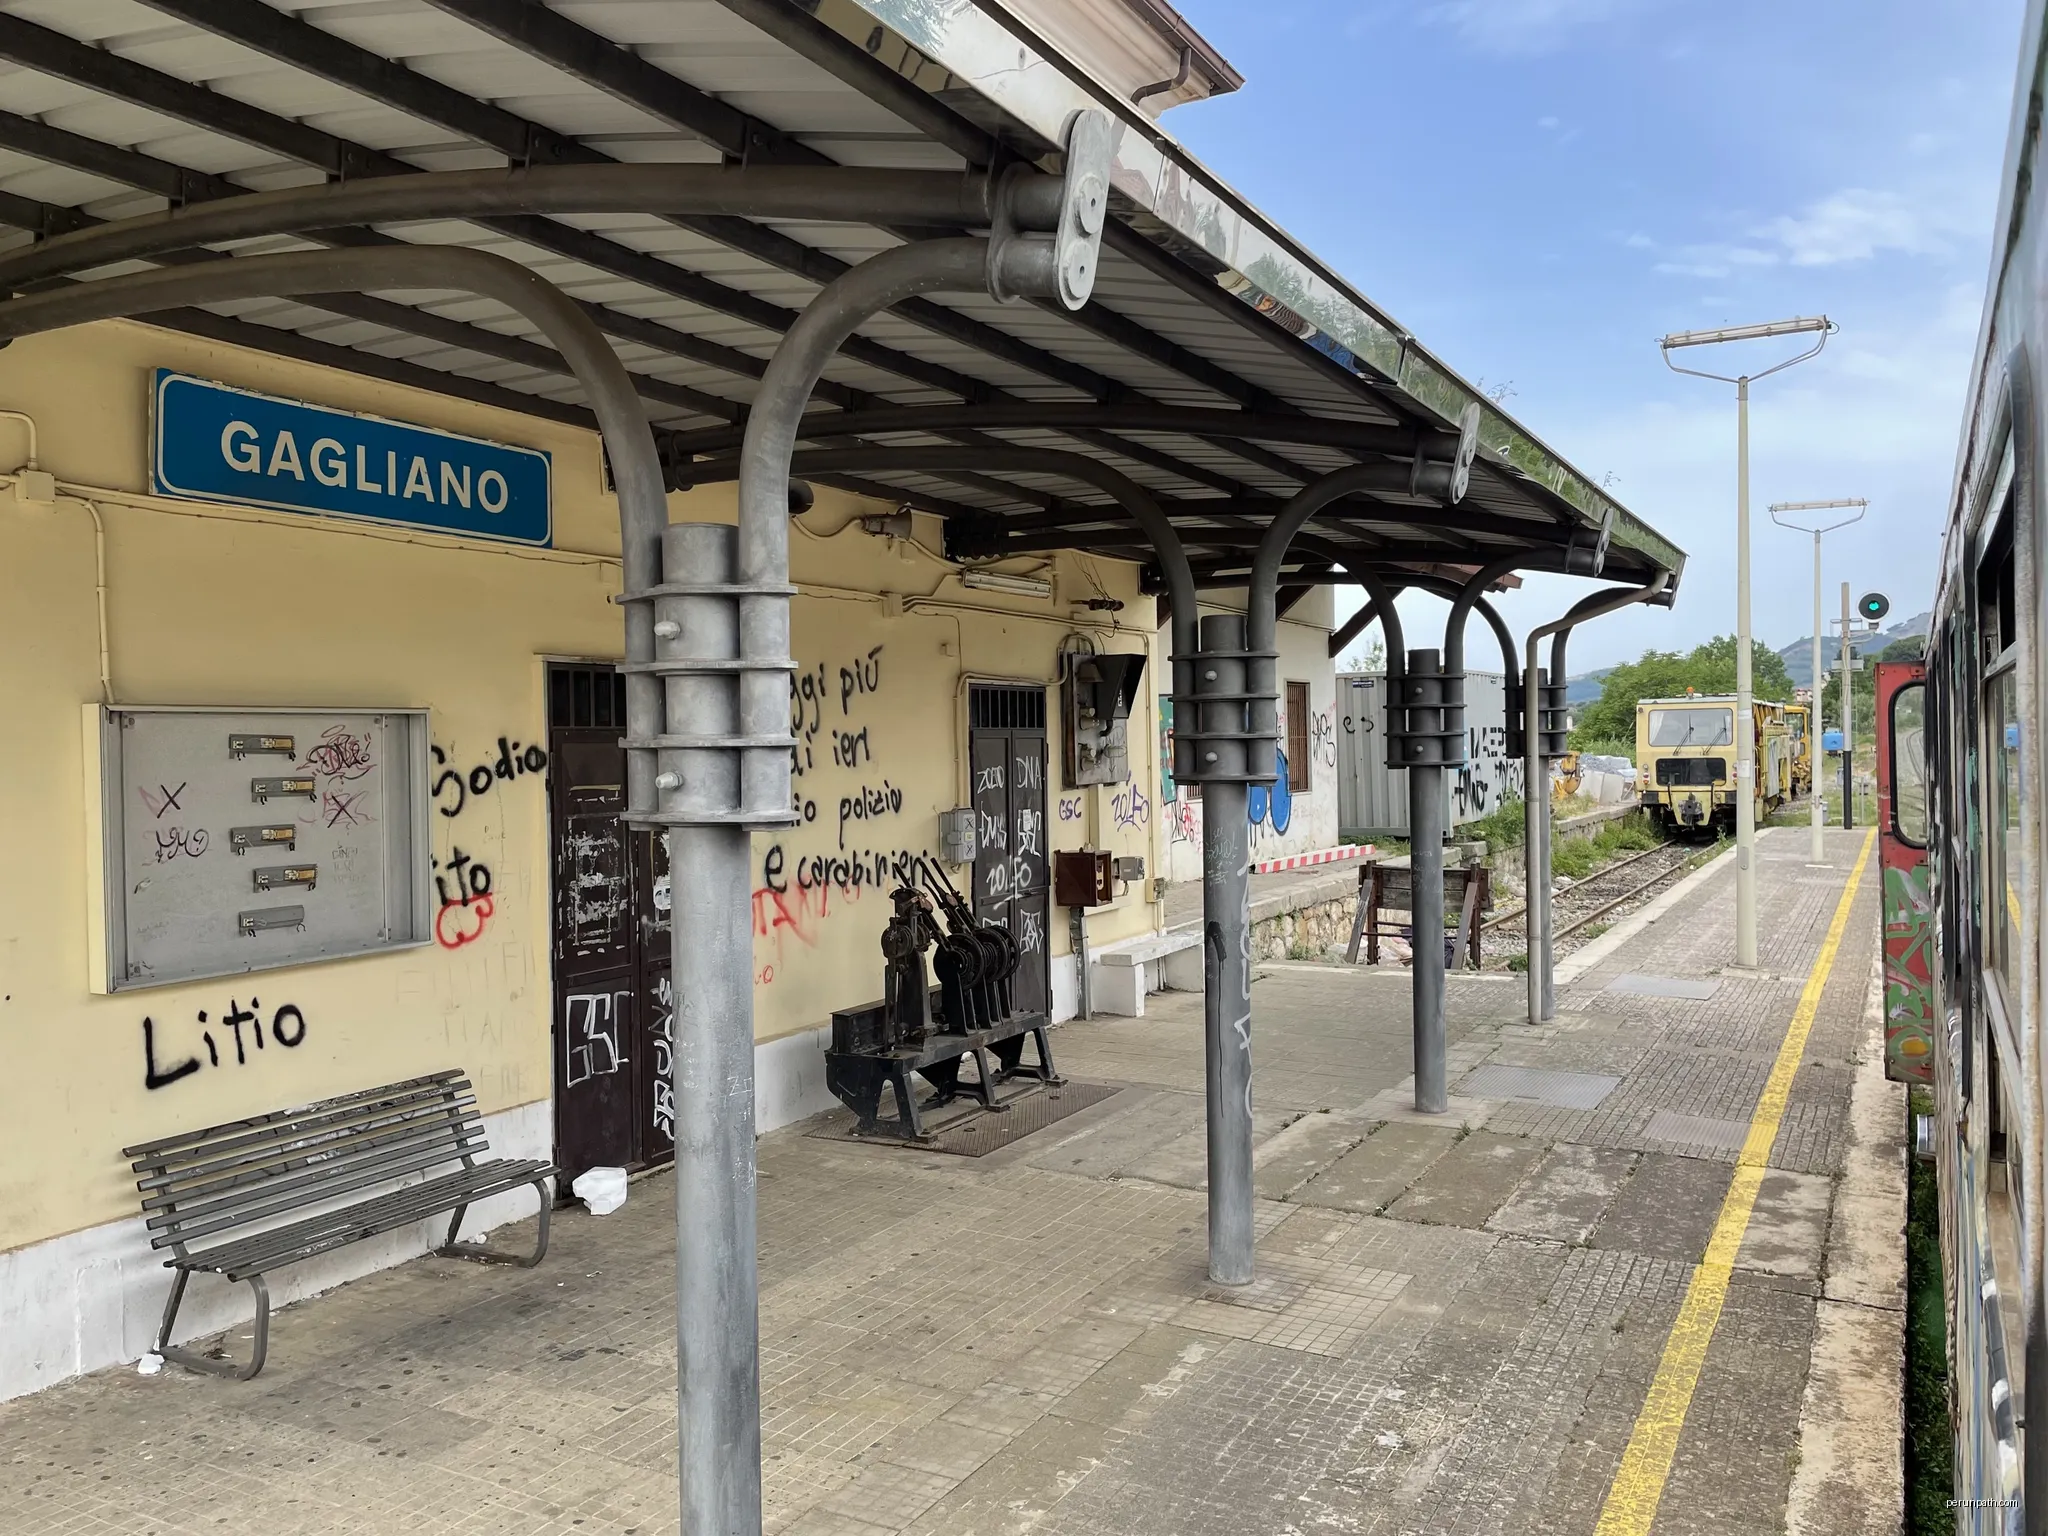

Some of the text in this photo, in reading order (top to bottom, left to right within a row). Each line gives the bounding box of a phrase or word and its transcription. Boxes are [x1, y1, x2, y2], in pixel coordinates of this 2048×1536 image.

[221, 420, 509, 514] GAGLIANO
[1058, 796, 1082, 820] GSC
[140, 997, 307, 1090] Litio
